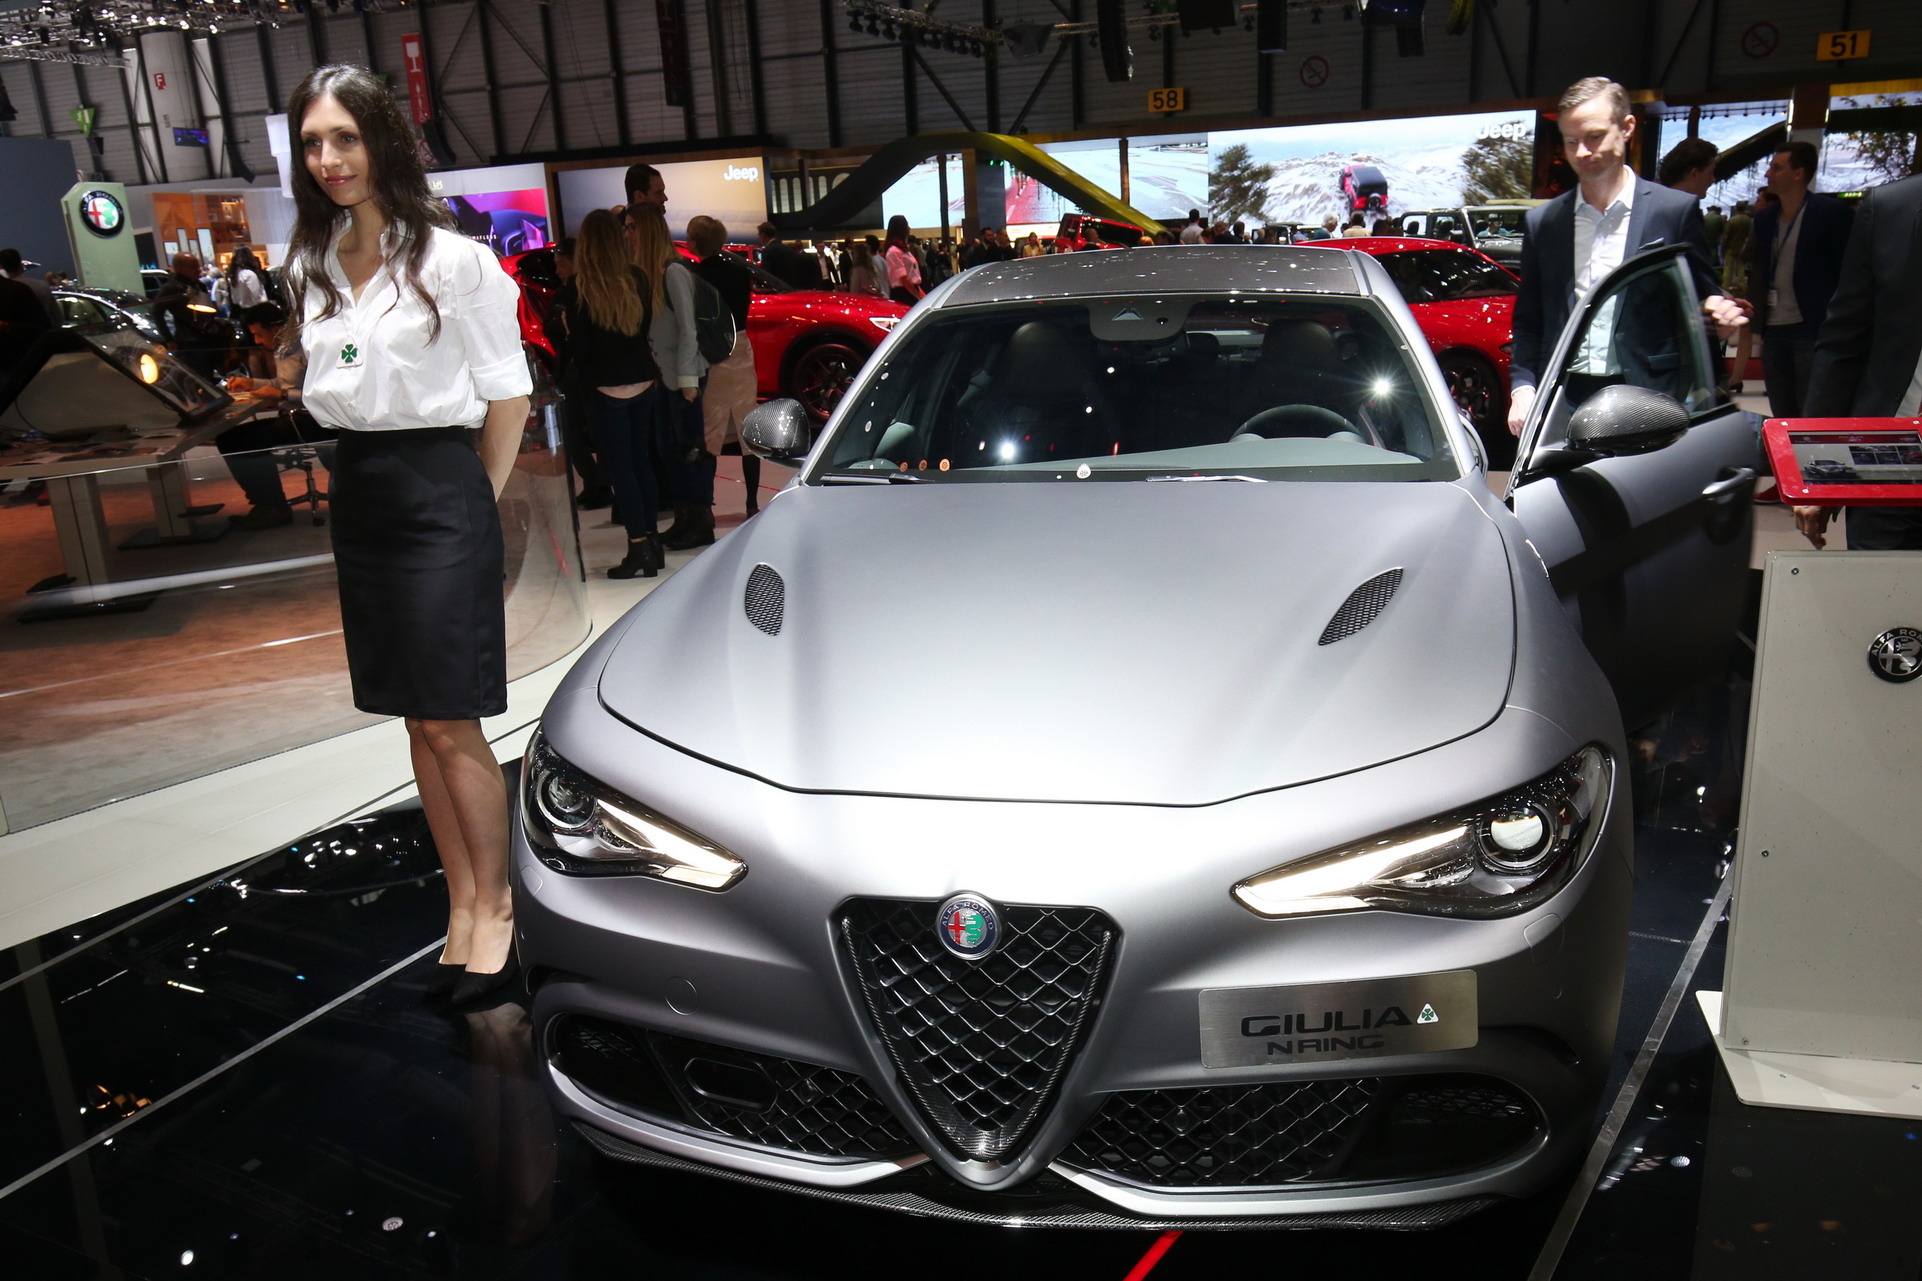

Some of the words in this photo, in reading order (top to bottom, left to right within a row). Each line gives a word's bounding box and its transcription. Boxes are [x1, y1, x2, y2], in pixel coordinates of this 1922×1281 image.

[1831, 33, 1857, 57] 51
[1153, 90, 1178, 110] 58
[1476, 120, 1526, 141] Jeep
[723, 164, 758, 182] Jeep
[1871, 632, 1894, 656] ALFA
[942, 903, 960, 927] ALFA
[963, 901, 994, 930] ROMEO
[1241, 1006, 1412, 1038] GIULIA
